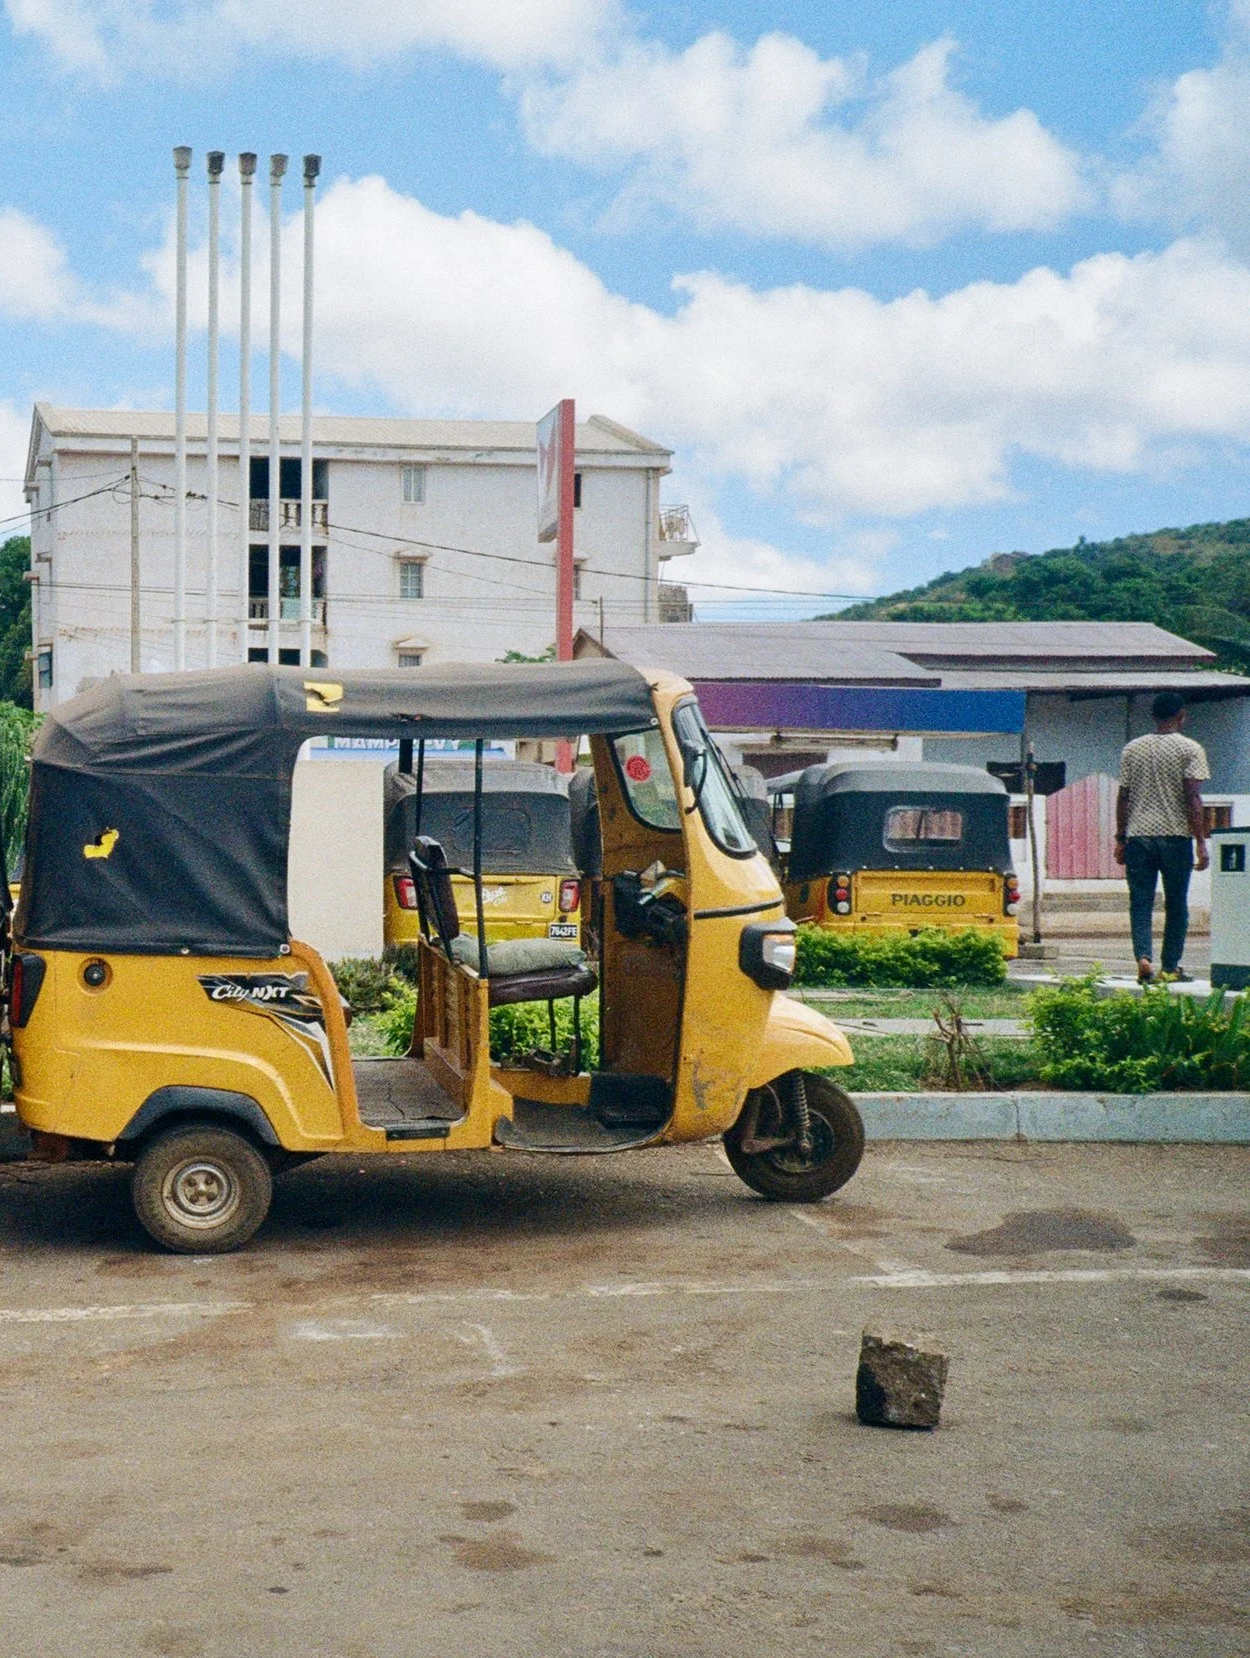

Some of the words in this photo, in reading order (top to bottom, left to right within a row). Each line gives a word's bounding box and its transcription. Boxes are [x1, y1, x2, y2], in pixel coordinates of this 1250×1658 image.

[892, 894, 965, 906] PIAGGIO
[211, 985, 250, 1002] City
[251, 985, 289, 1000] NXT
